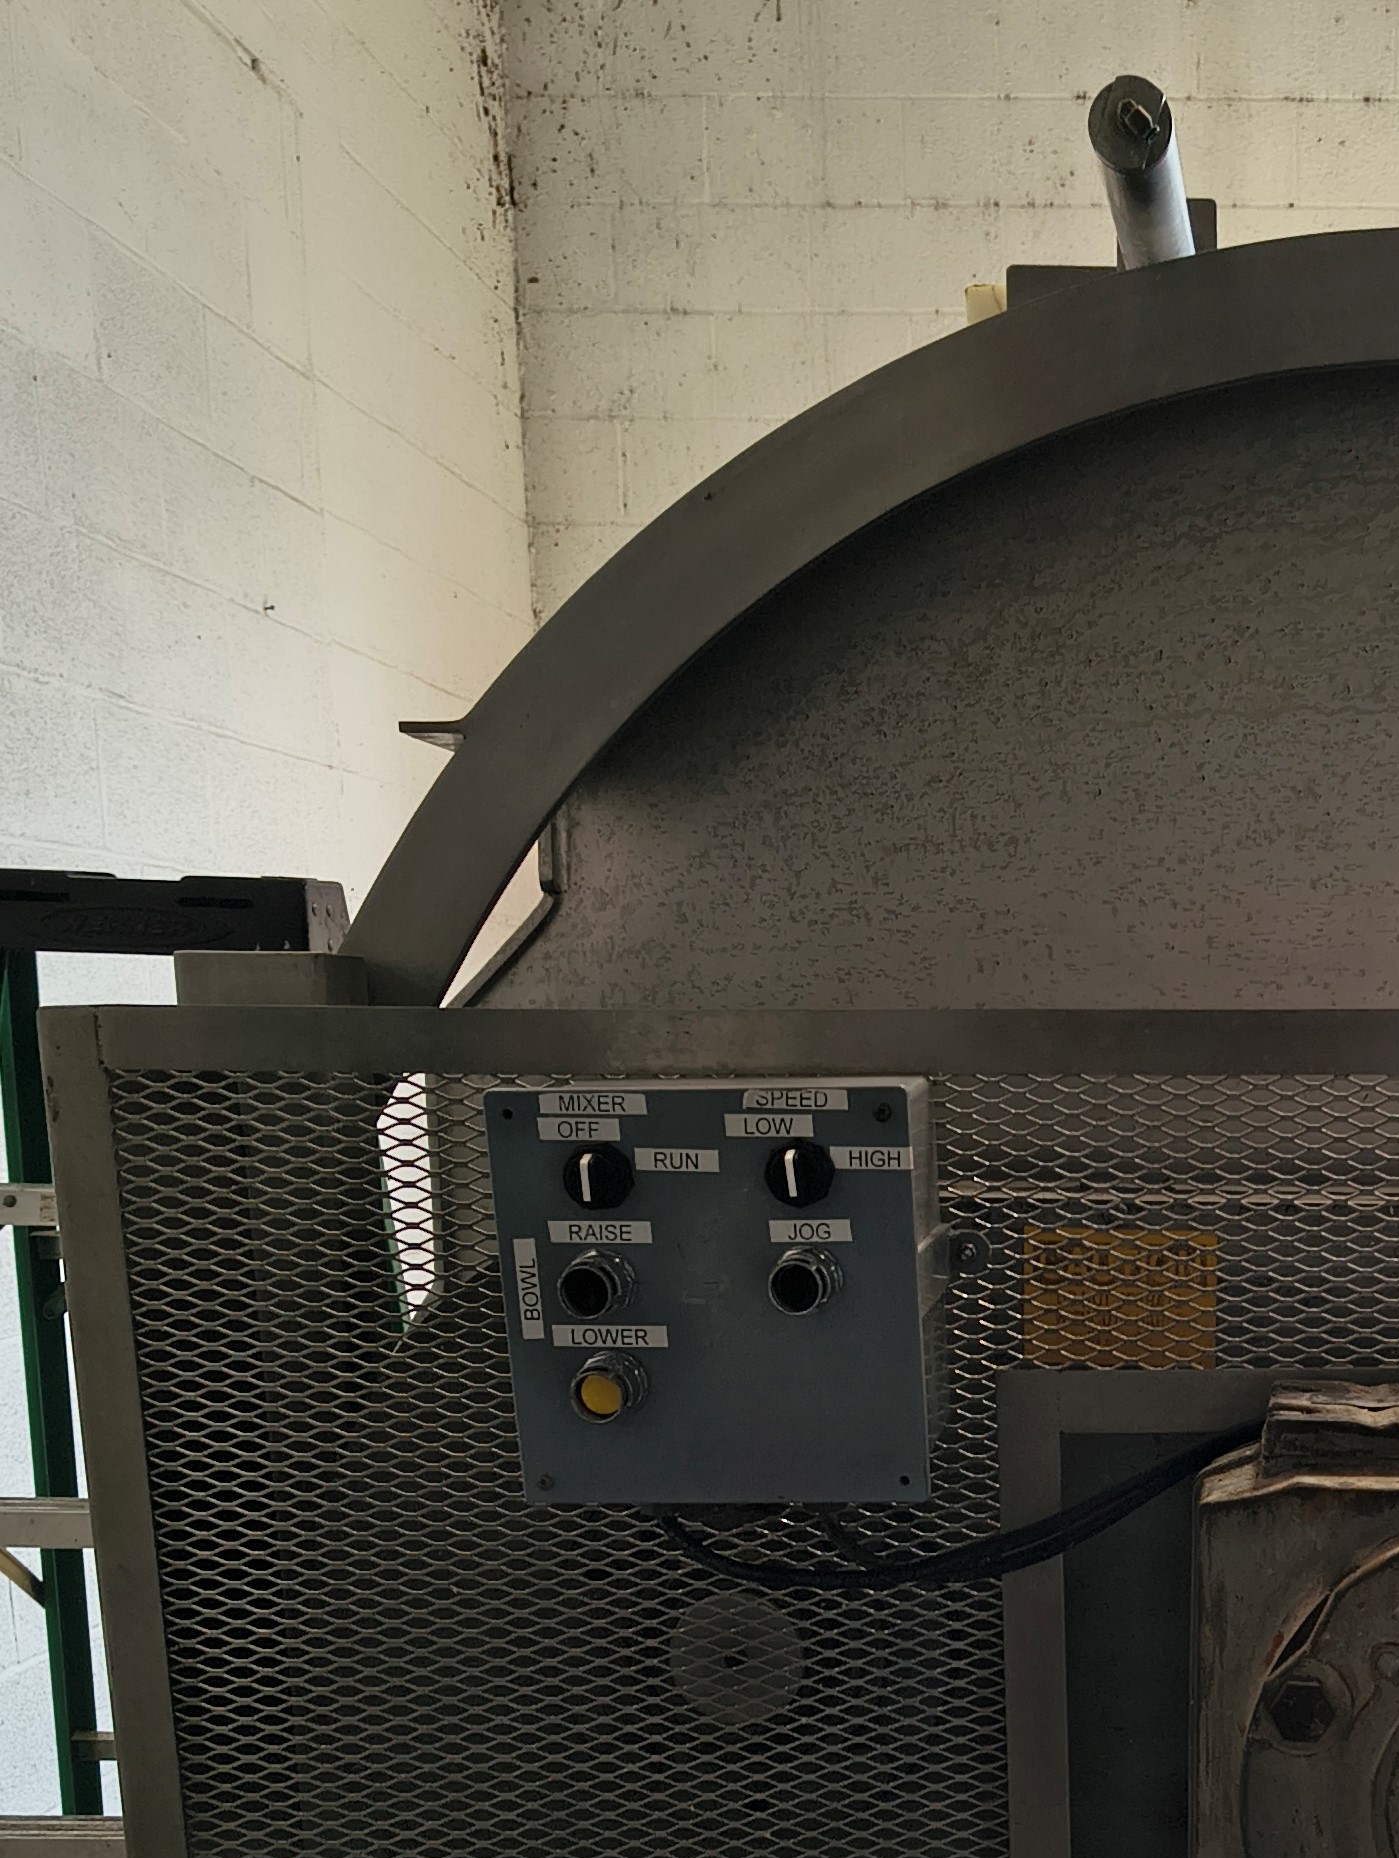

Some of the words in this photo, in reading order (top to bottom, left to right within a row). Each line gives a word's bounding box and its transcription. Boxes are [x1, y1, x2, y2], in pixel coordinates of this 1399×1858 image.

[558, 1094, 626, 1113] MIXER
[756, 1090, 828, 1108] SPEED
[557, 1120, 600, 1139] OFF
[743, 1117, 793, 1136] LOW
[653, 1151, 699, 1170] RUN
[848, 1149, 901, 1168] HIGH
[568, 1223, 633, 1242] RAISE
[787, 1222, 831, 1241] JOG
[518, 1258, 541, 1321] BOWL
[570, 1328, 649, 1346] LOWER
